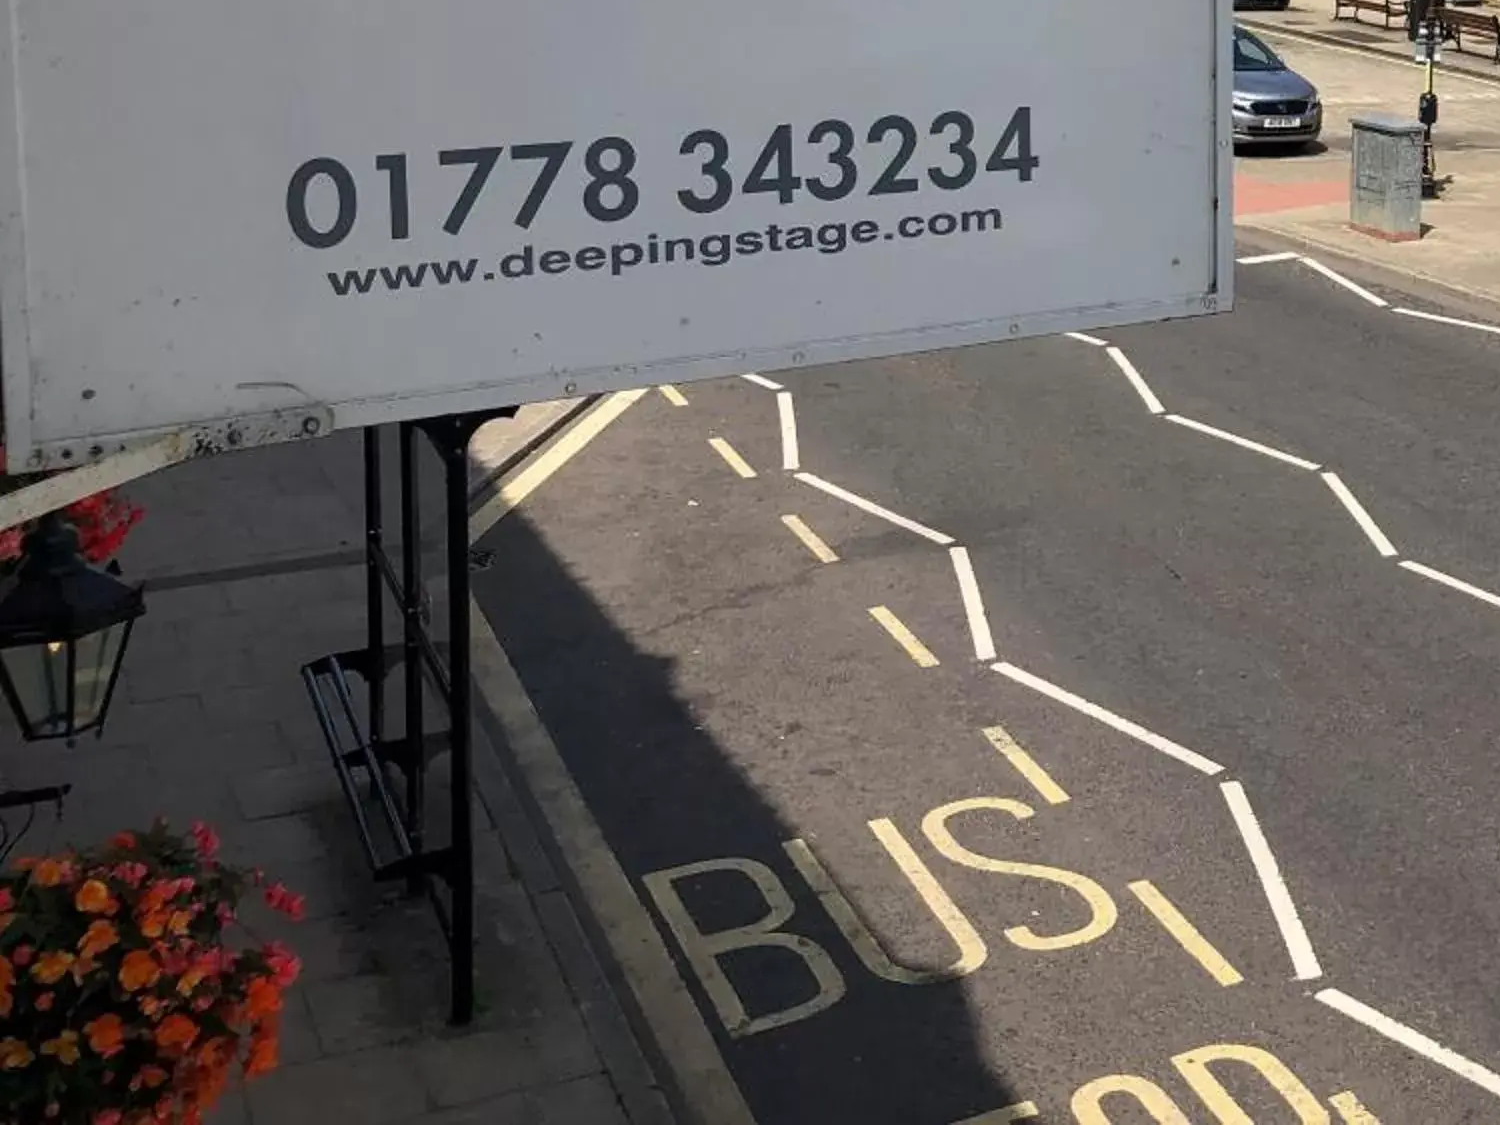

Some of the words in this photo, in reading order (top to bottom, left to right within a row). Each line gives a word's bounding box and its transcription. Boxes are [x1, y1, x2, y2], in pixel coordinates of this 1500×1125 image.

[285, 136, 639, 250] 01778
[676, 106, 1040, 214] 343234
[327, 206, 1003, 296] www.deepingstage.com
[641, 796, 1118, 1038] BUS
